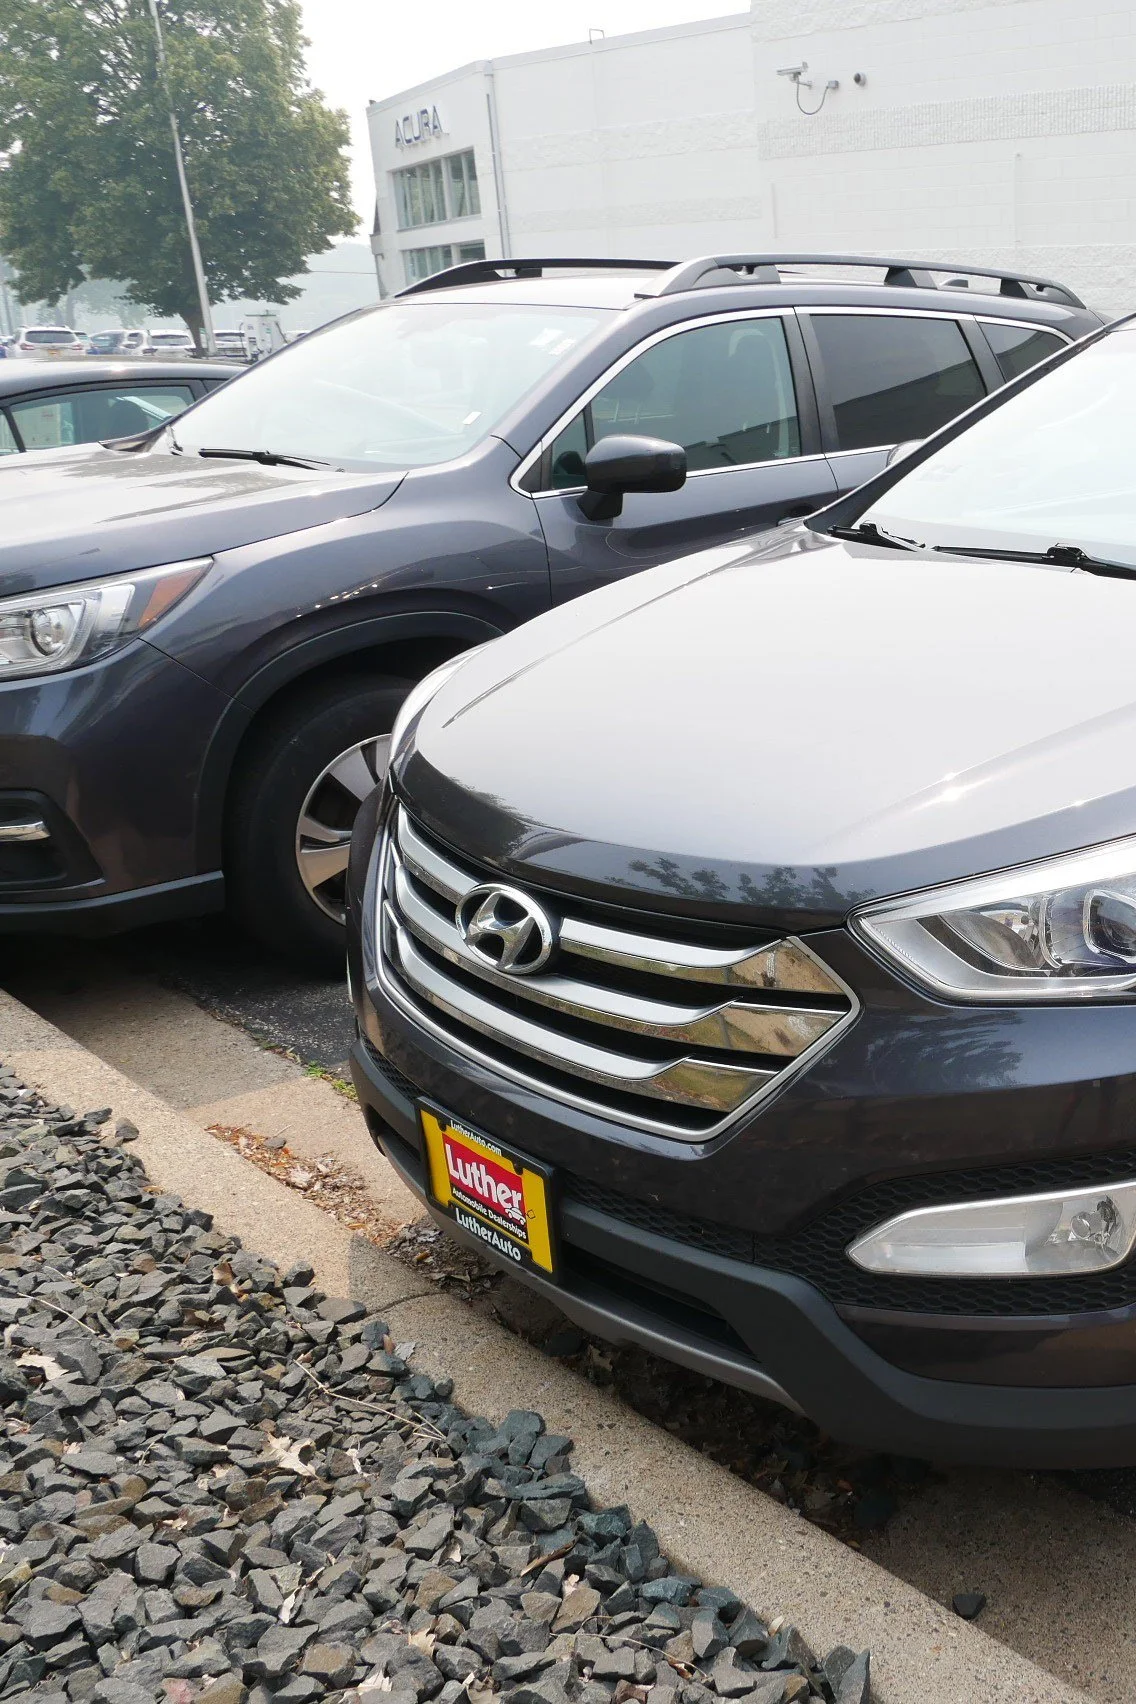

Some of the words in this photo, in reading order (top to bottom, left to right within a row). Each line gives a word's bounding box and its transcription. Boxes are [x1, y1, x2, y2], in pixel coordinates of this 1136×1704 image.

[394, 105, 443, 148] ACURA
[450, 1119, 502, 1157] LutherAuto.com
[445, 1143, 522, 1209] Luther
[452, 1187, 488, 1216] Automobile
[488, 1209, 527, 1240] Dealerships
[455, 1207, 522, 1262] LutherAuto
